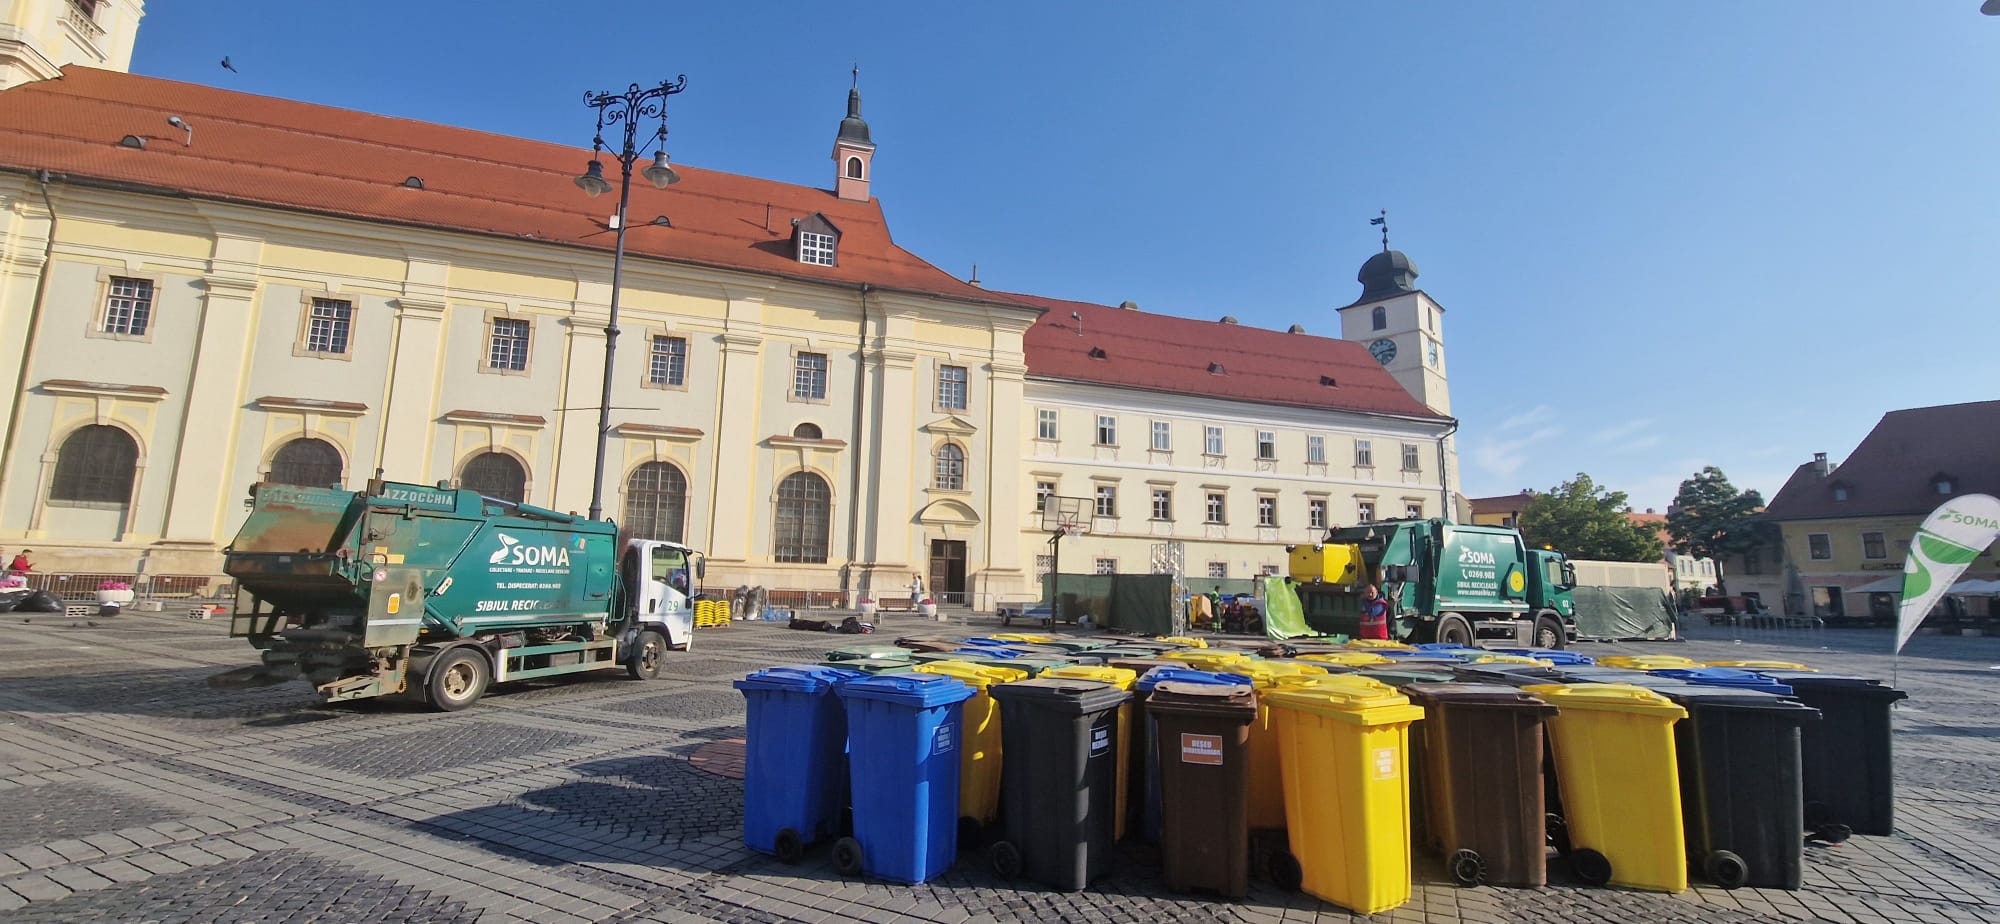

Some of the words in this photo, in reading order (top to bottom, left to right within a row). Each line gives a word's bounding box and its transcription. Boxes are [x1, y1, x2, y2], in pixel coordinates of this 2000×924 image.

[377, 488, 453, 505] AZZOCCHIA
[1952, 513, 1999, 529] SOMA
[512, 545, 569, 566] SOMA
[1467, 551, 1495, 564] SOMA
[475, 600, 509, 612] SIBIUL
[668, 600, 679, 612] 29
